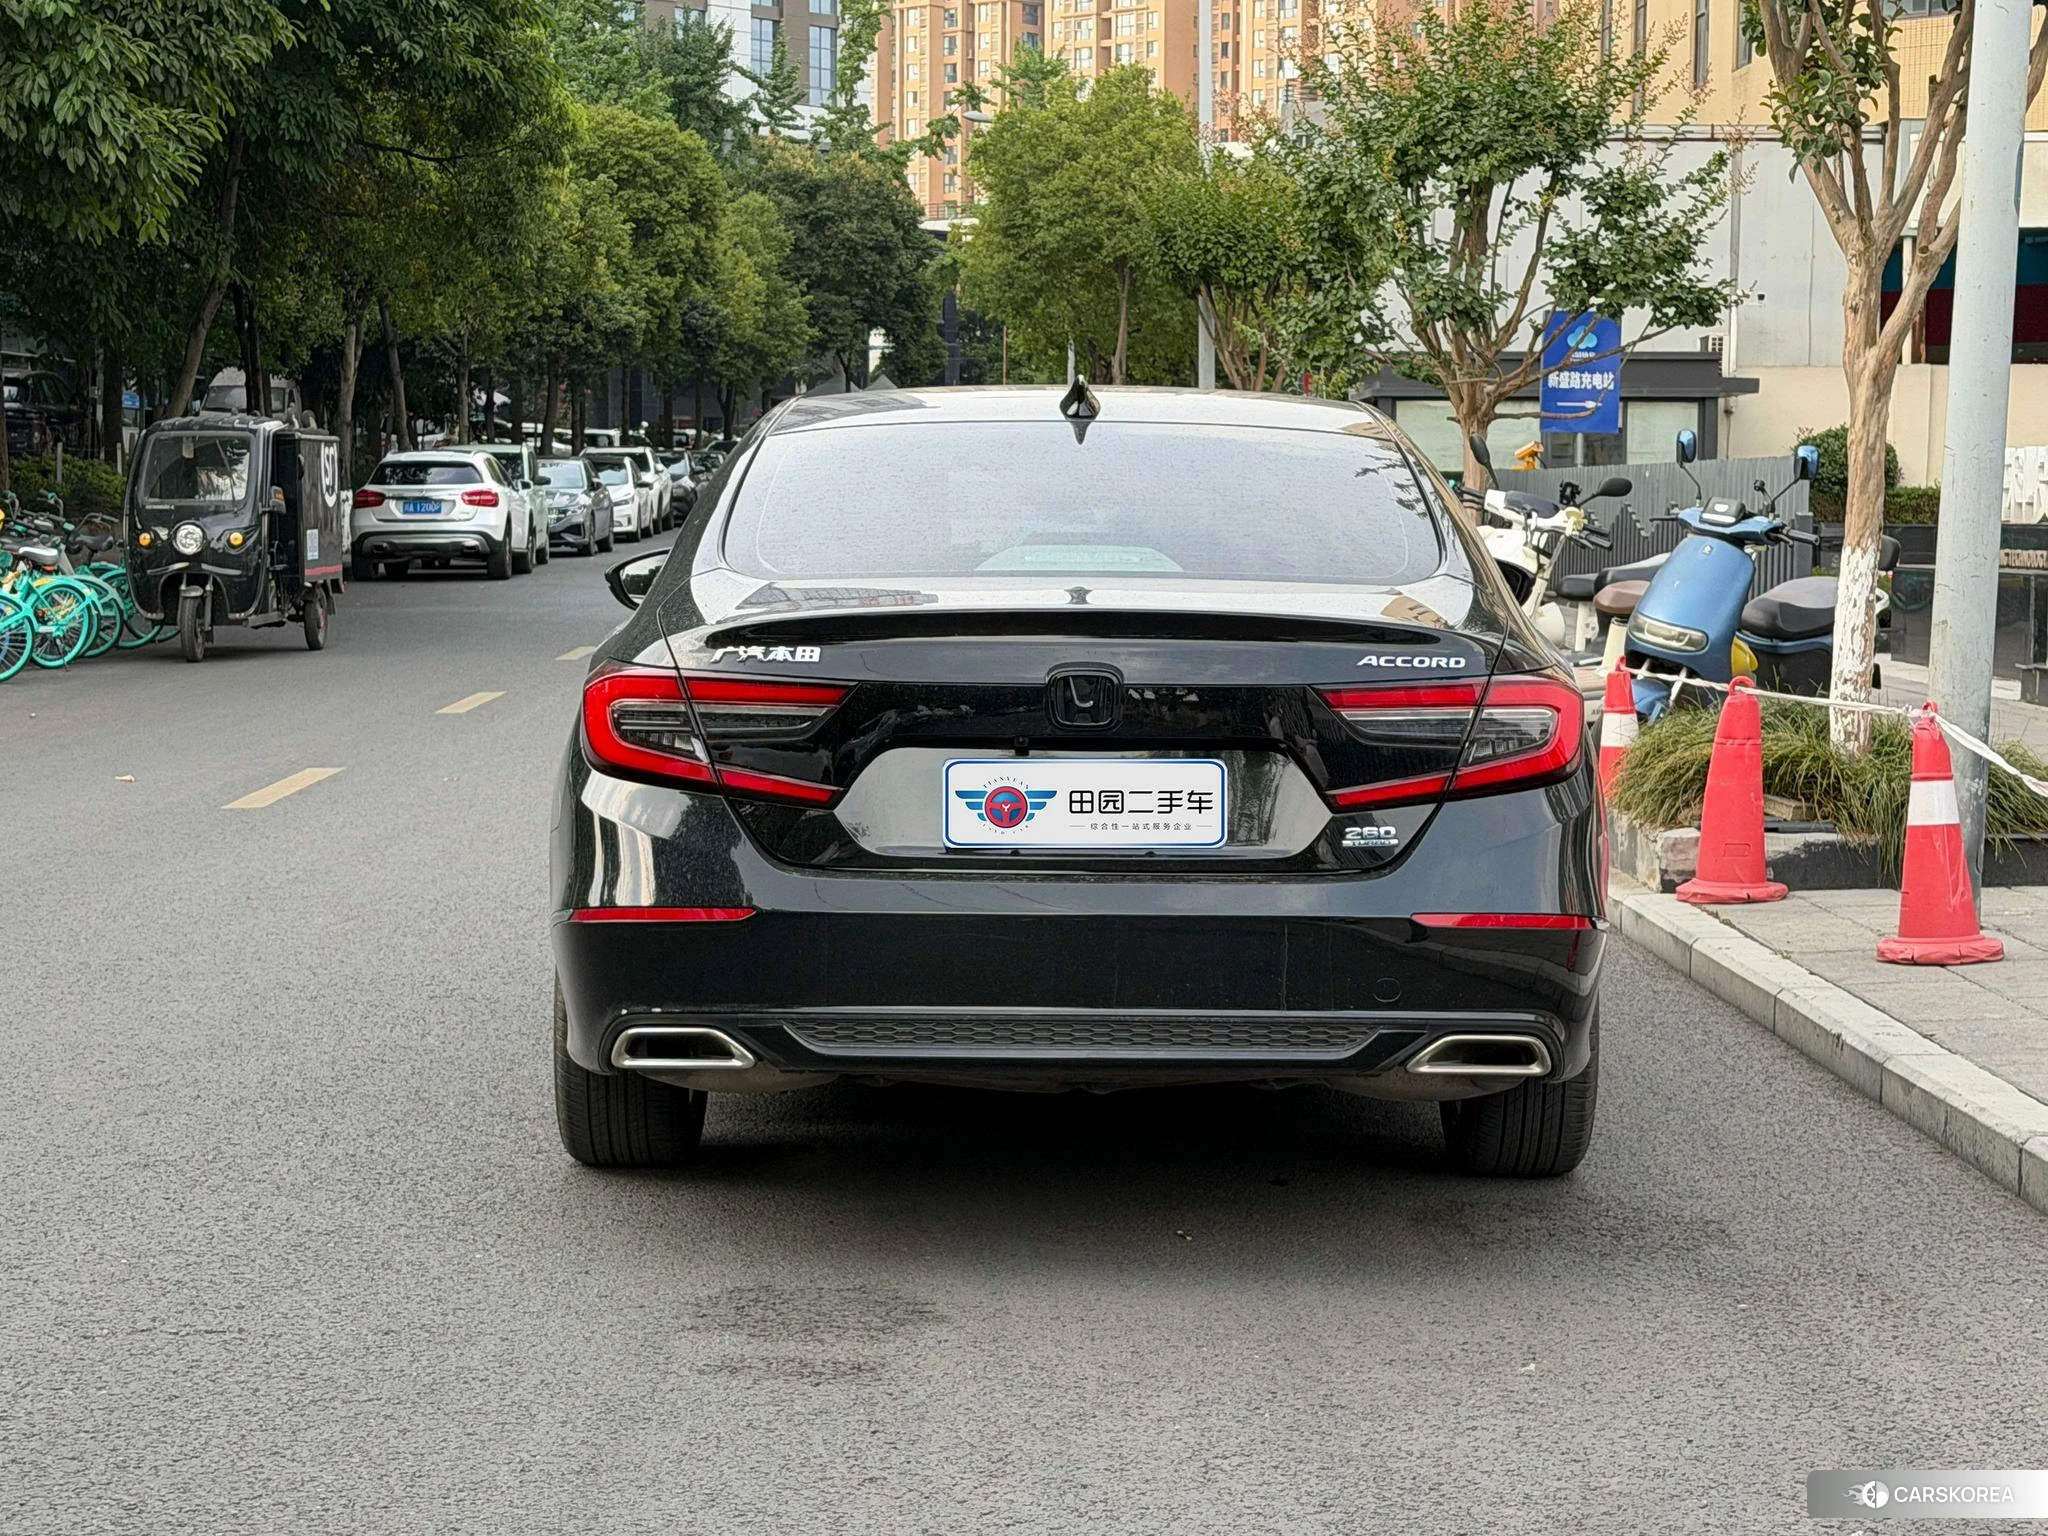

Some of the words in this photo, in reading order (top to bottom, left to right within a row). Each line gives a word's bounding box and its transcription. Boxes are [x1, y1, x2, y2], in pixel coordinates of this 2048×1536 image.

[1547, 370, 1615, 390] 新盛路充电站
[710, 645, 821, 662] 广汽本田
[1356, 655, 1466, 668] ACCORD
[1068, 789, 1214, 814] 田园二手车
[1090, 822, 1192, 831] 综合性一站式服务企业
[1344, 826, 1397, 839] 260
